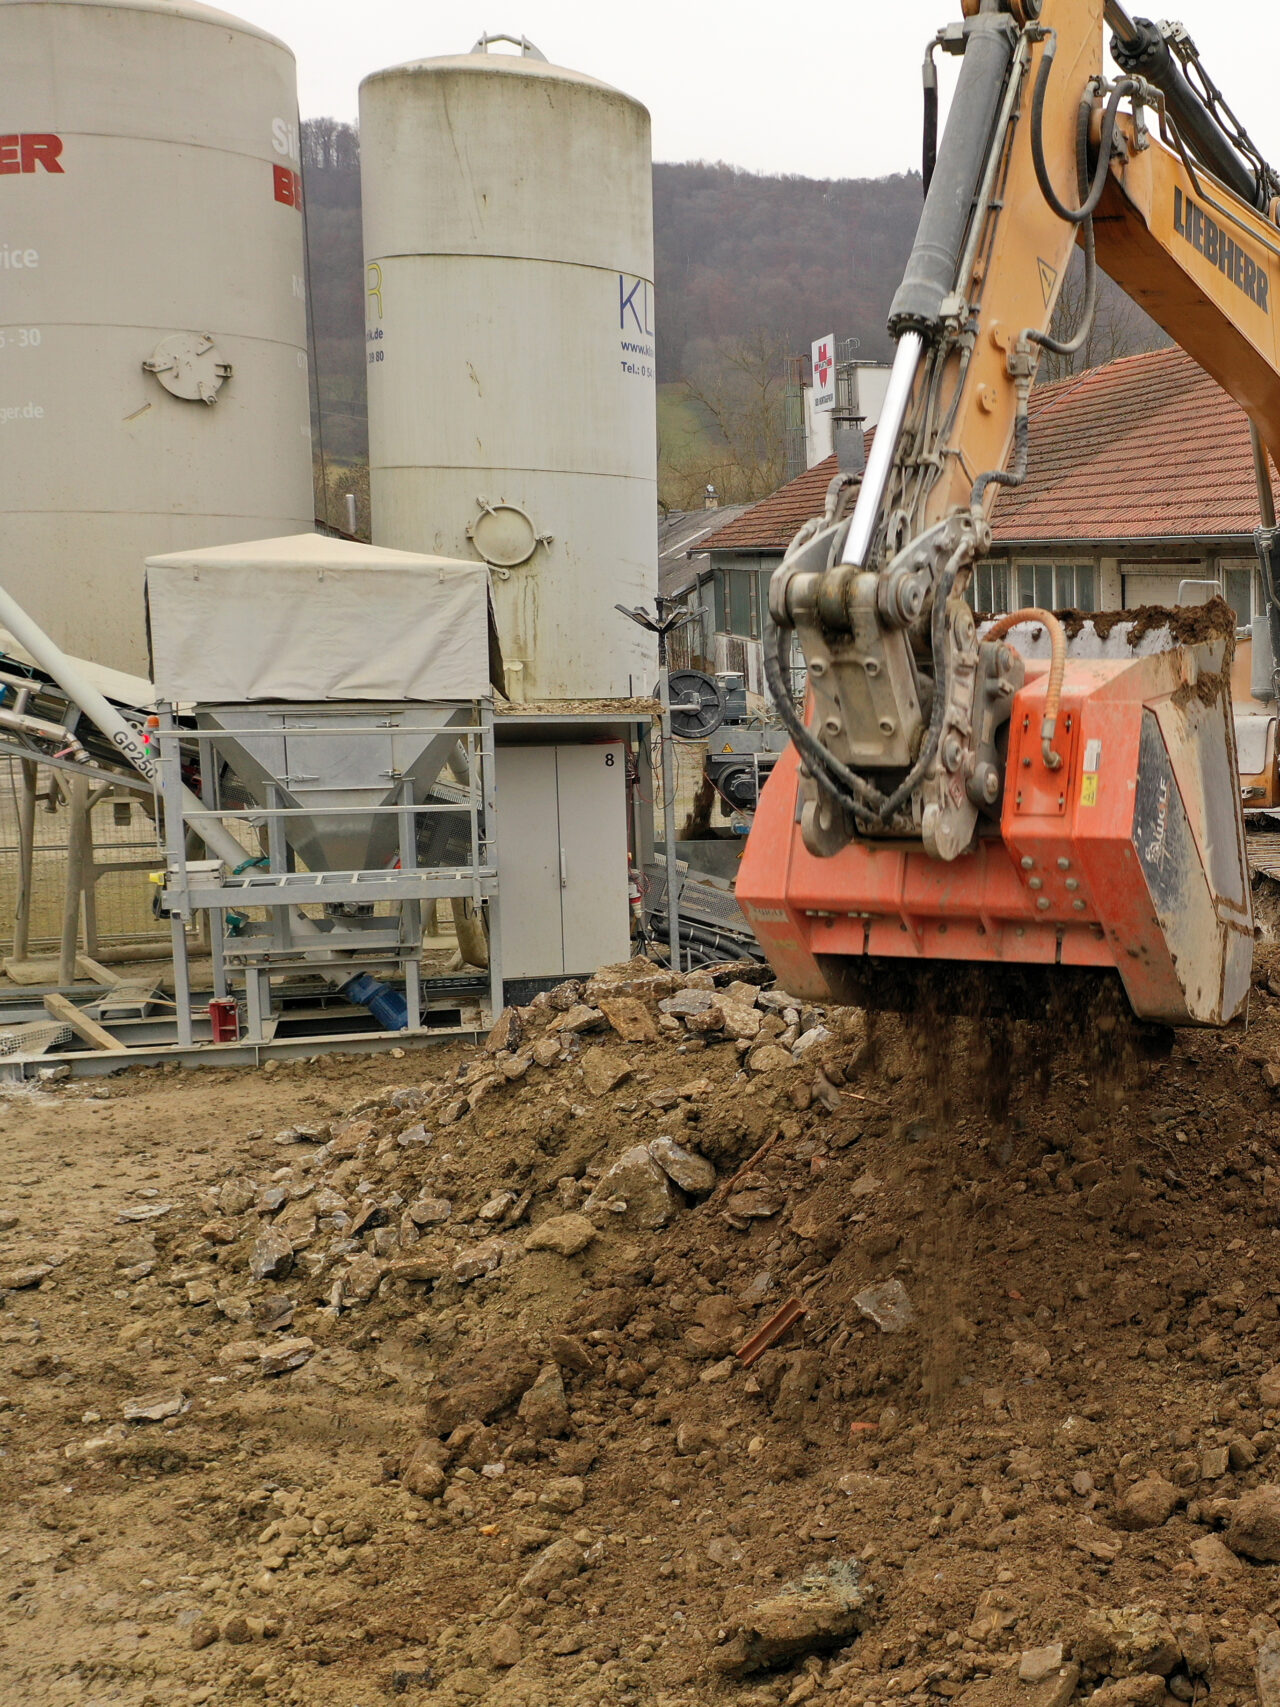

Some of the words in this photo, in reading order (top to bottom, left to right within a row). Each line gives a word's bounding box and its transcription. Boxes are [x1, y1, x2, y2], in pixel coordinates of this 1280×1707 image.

[1174, 185, 1269, 315] LIEBHERR
[18, 328, 41, 347] 30
[375, 351, 384, 362] 80
[621, 361, 640, 376] Tel.:
[113, 731, 158, 779] GP250
[605, 753, 615, 767] 8
